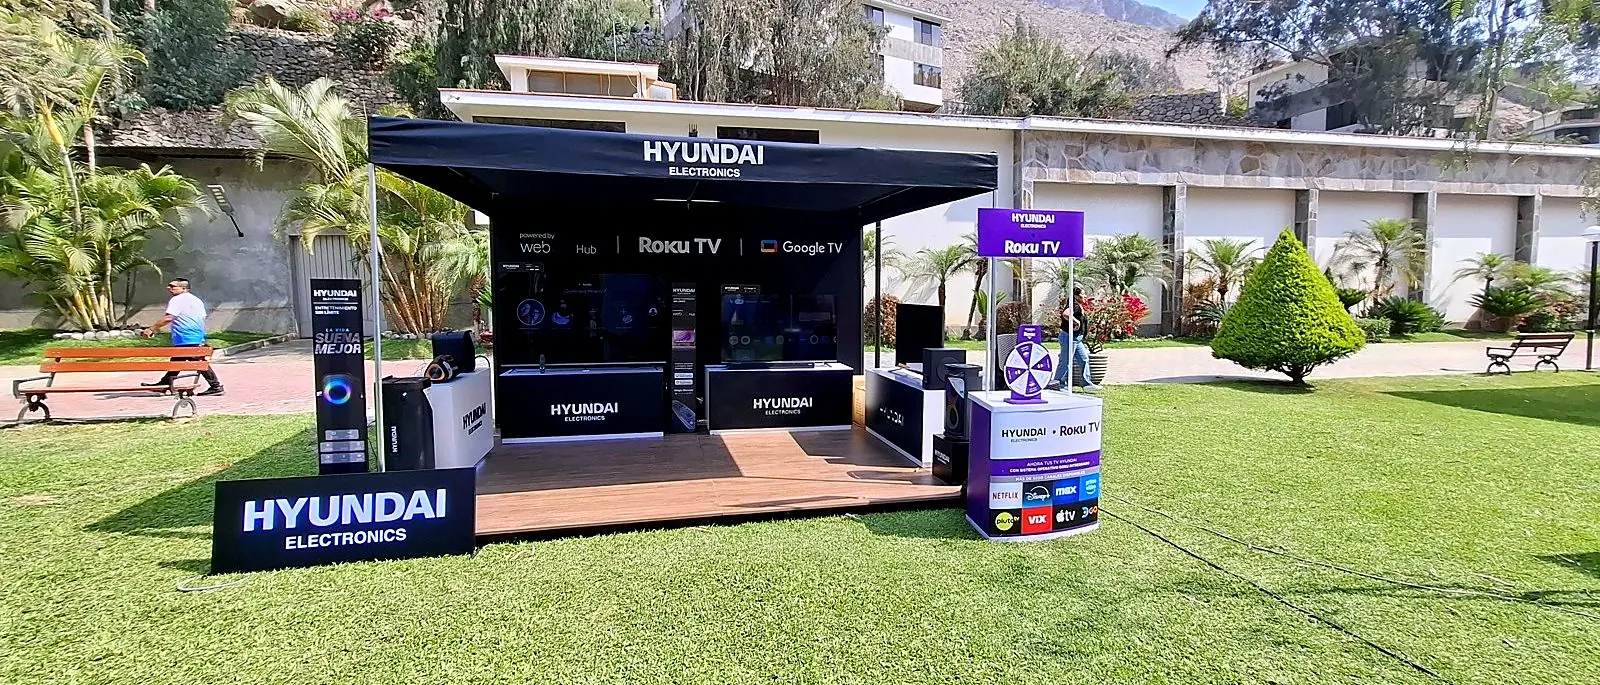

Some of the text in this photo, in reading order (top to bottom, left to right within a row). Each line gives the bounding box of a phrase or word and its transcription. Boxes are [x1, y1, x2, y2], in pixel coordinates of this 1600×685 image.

[643, 140, 764, 165] HYUNDAI
[669, 166, 741, 178] ELECTRONICS
[1011, 213, 1055, 224] HYUNDAI
[520, 241, 597, 255] web Hub
[694, 238, 722, 254] TV
[782, 241, 843, 256] Google TV
[1041, 241, 1060, 254] TV
[313, 289, 358, 297] HYUNDAI
[315, 332, 361, 344] SUENA
[315, 343, 362, 354] MEJOR
[550, 402, 619, 416] HYUNDAI
[753, 396, 813, 409] HYUNDAI
[462, 402, 487, 429] HYUNDAI
[1001, 428, 1046, 438] HYUNDAI
[1089, 421, 1100, 432] TV
[992, 491, 1019, 500] NETFLIX
[1055, 486, 1077, 496] max
[243, 488, 447, 532] HYUNDAI
[1065, 509, 1076, 522] tv
[285, 528, 407, 550] ELECTRONICS
